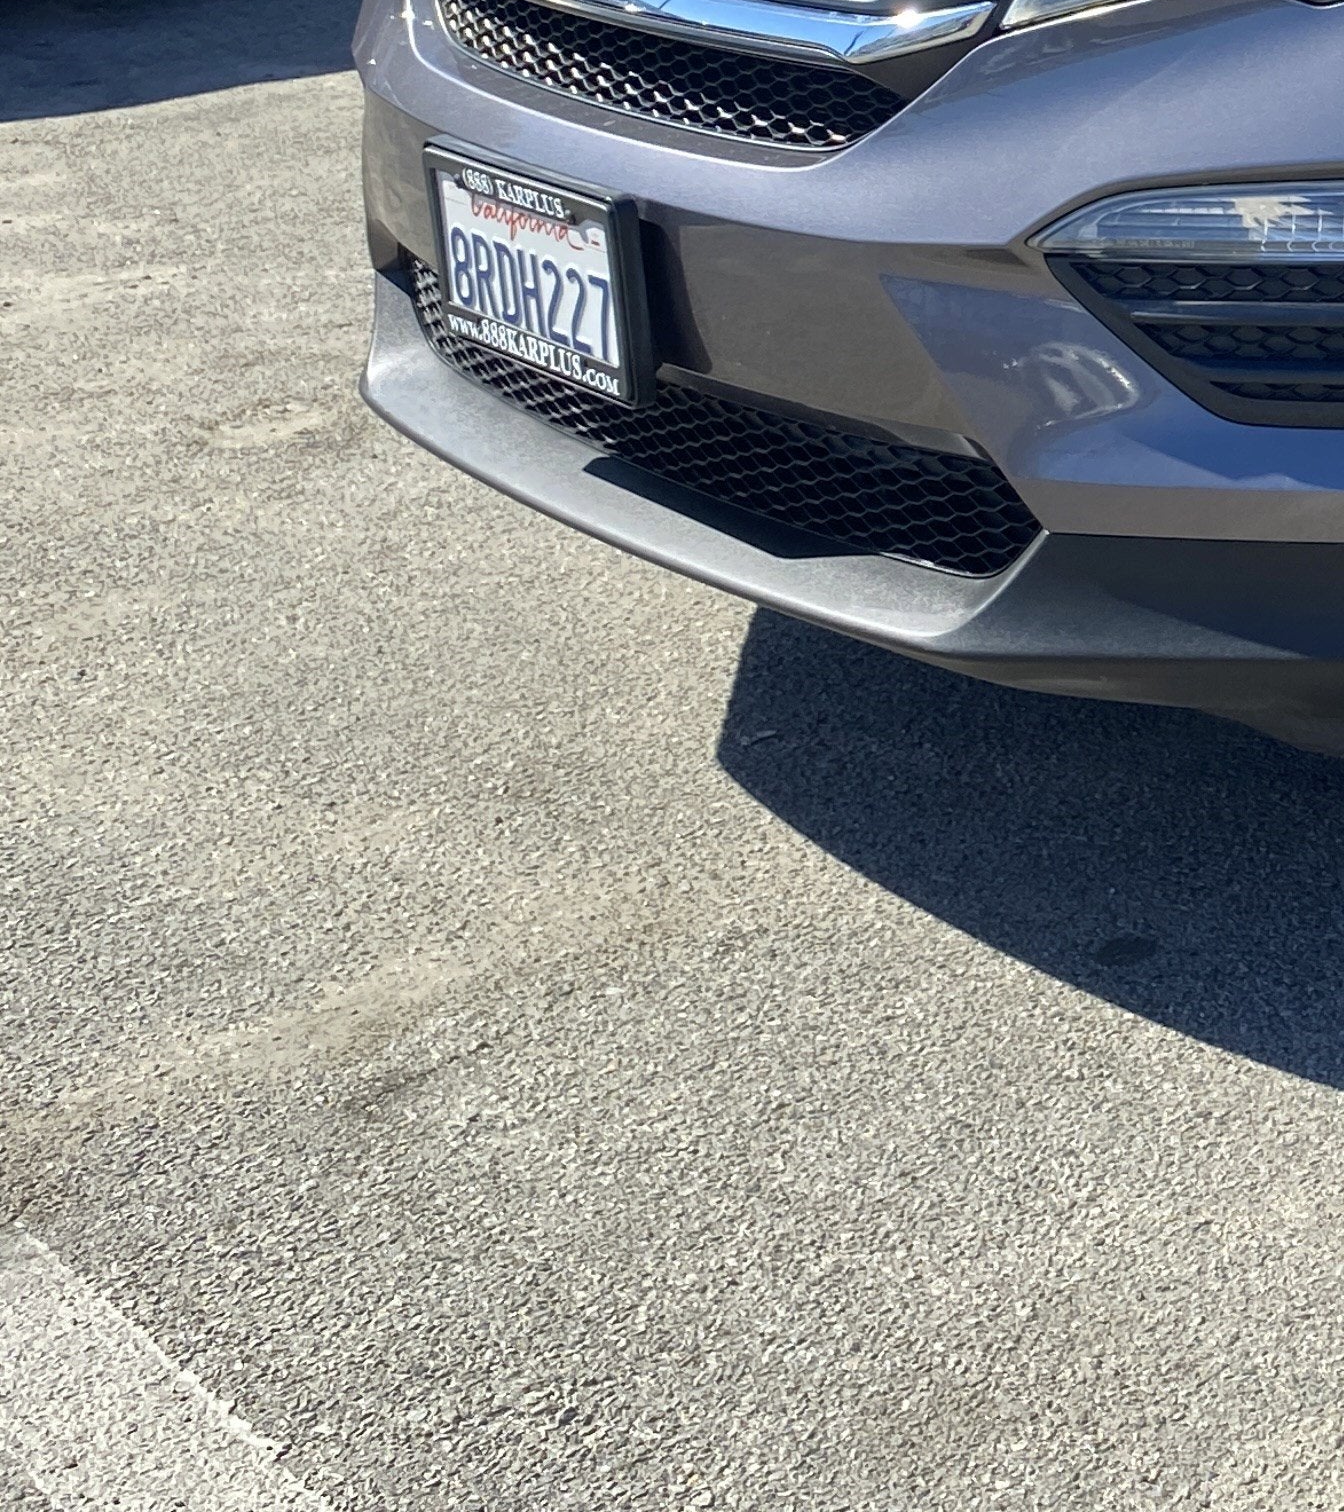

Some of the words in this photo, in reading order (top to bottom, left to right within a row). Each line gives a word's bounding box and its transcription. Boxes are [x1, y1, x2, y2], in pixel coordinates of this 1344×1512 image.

[462, 167, 494, 195] (888)
[494, 179, 565, 219] KARPLUS
[450, 226, 609, 361] 8RDH227
